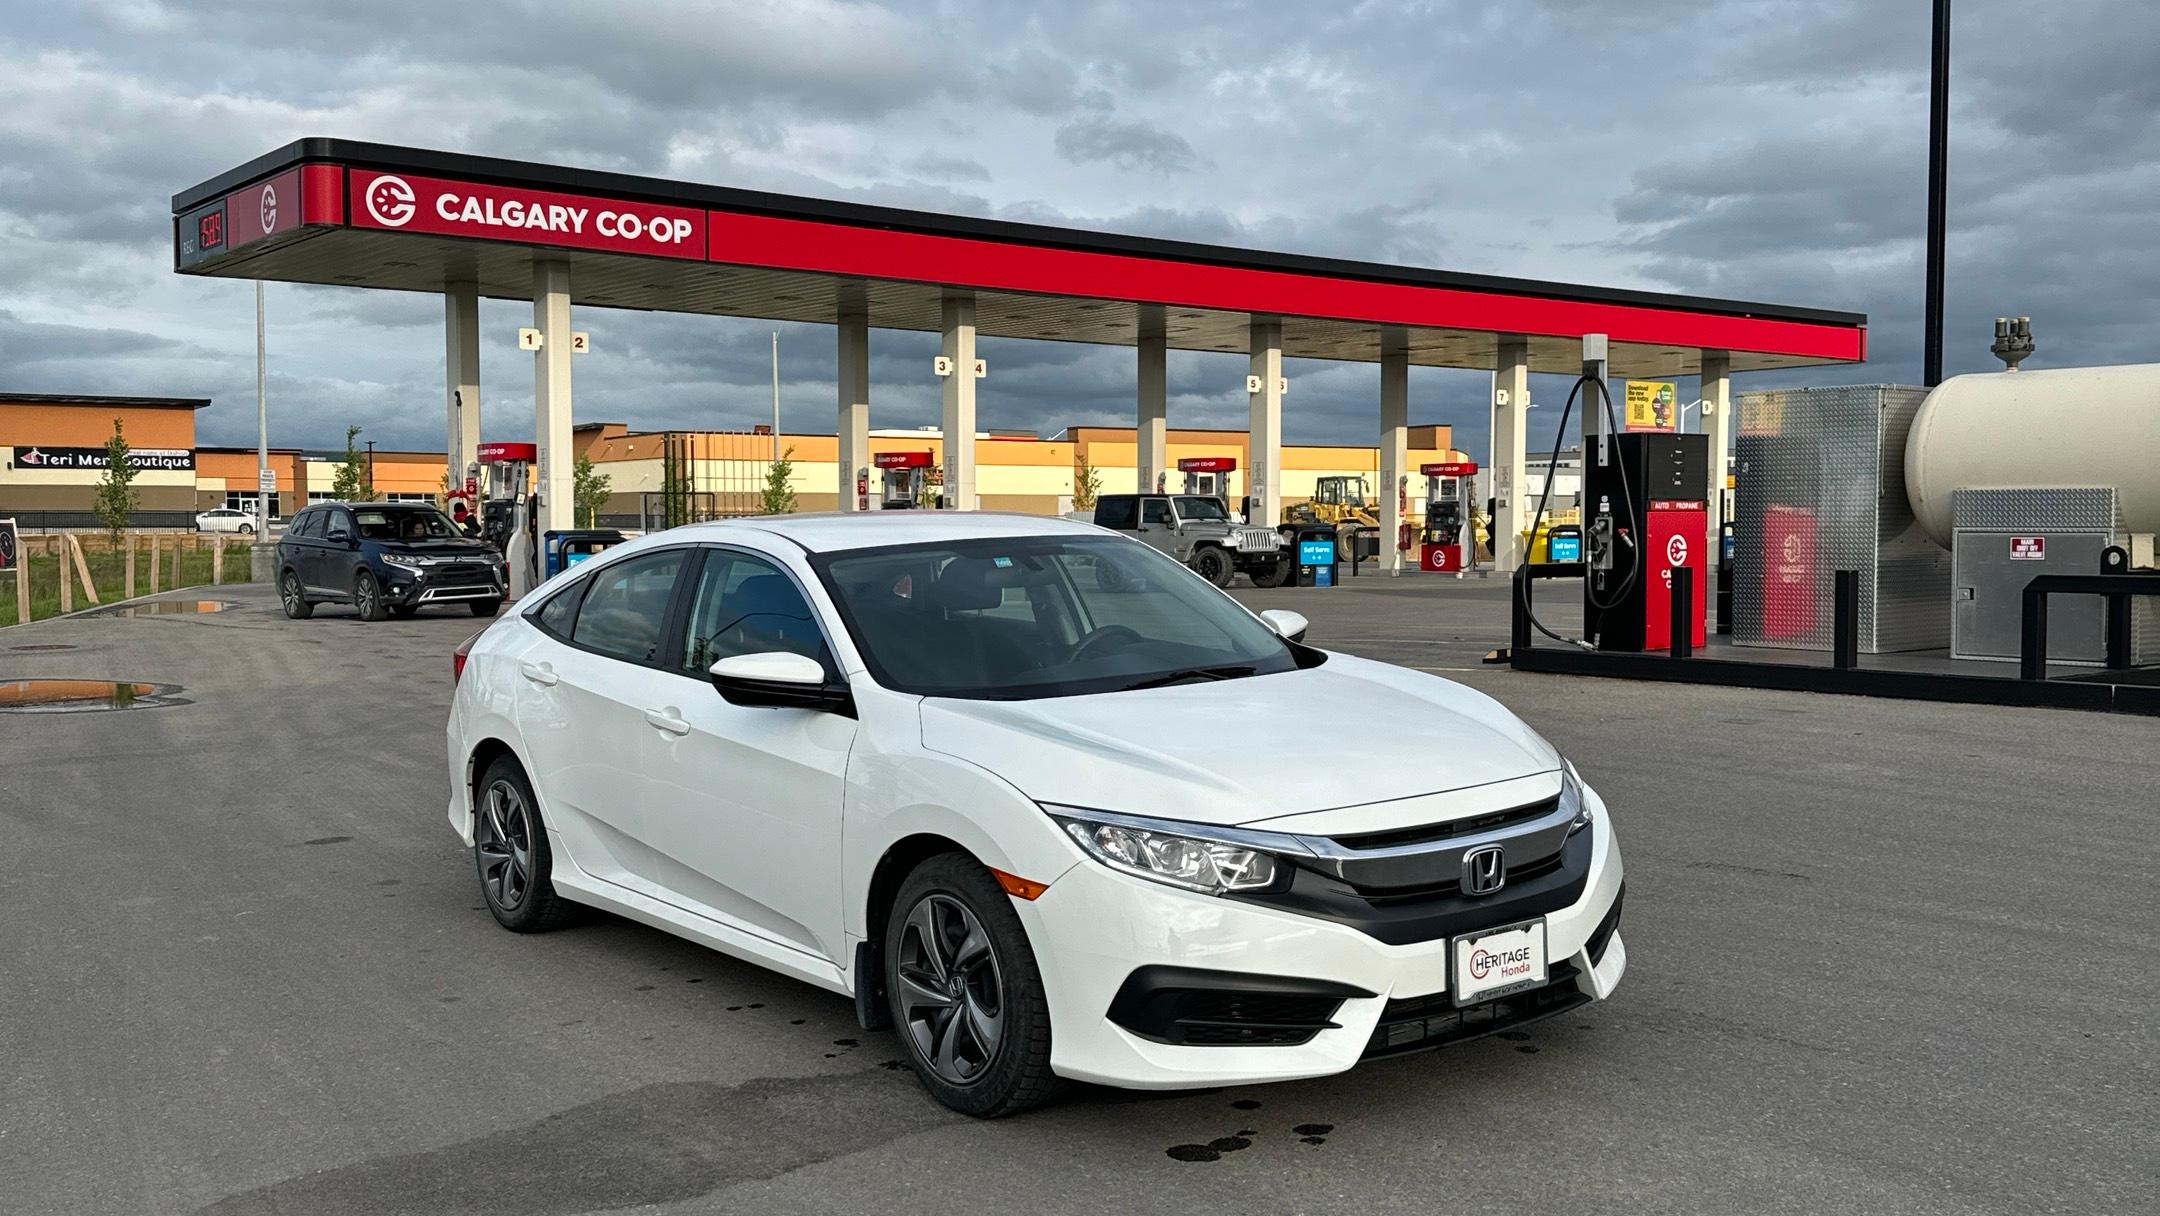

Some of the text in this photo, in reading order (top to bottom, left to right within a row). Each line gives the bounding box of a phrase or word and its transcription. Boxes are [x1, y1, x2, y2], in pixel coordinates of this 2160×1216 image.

[435, 193, 589, 234] CALGARY
[526, 333, 533, 345] 1
[574, 336, 584, 348] 2
[939, 360, 946, 371] 3
[975, 363, 983, 374] 4
[1250, 379, 1256, 388] 5
[1499, 393, 1505, 401] 7
[42, 453, 73, 466] Teri
[78, 454, 111, 466] Mer
[1654, 501, 1699, 510] AUTO PROPANE
[1476, 947, 1530, 970] HERITAGE
[1501, 961, 1530, 978] Honda
